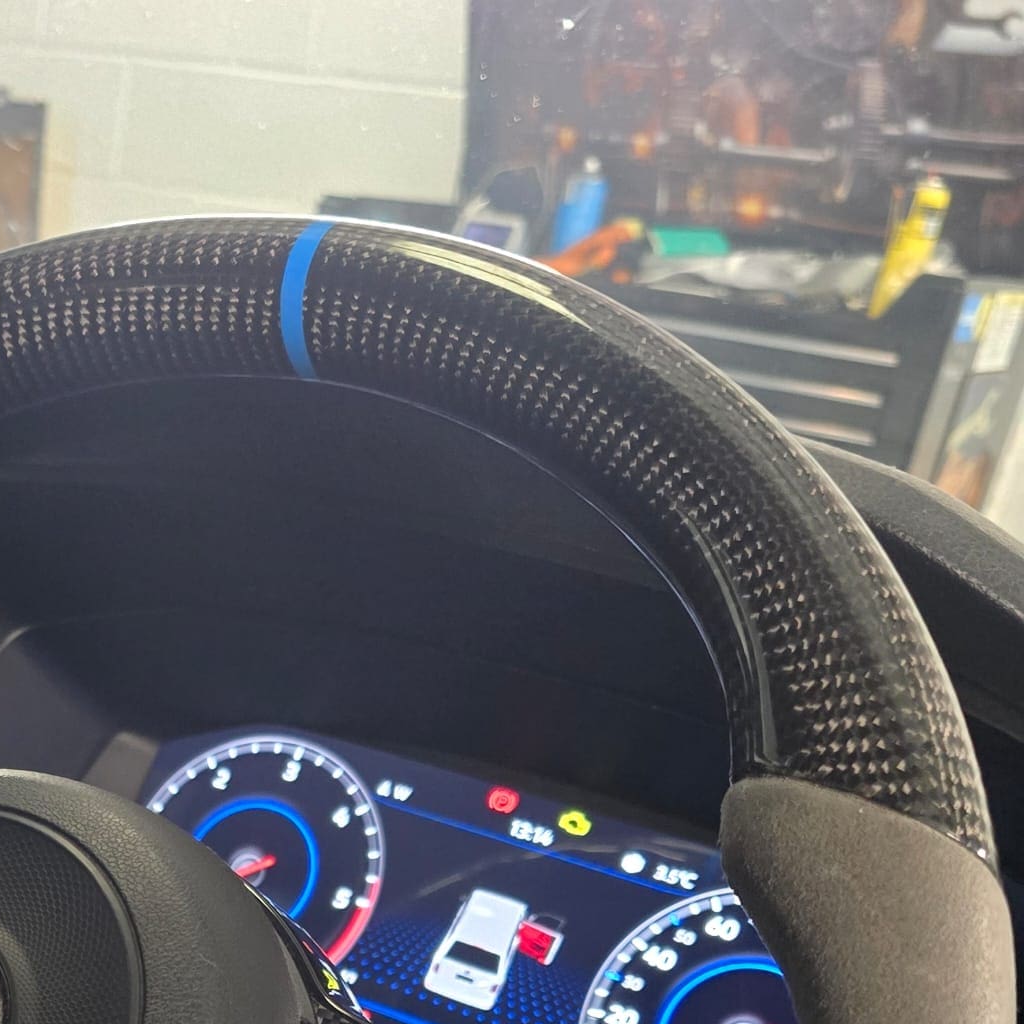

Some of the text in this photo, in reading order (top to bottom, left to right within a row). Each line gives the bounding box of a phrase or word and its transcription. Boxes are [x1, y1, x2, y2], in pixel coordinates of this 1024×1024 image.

[212, 767, 231, 790] 2
[282, 761, 301, 782] 3
[332, 806, 350, 828] 4
[332, 887, 353, 909] 5
[705, 916, 740, 941] 60
[643, 945, 678, 971] 40
